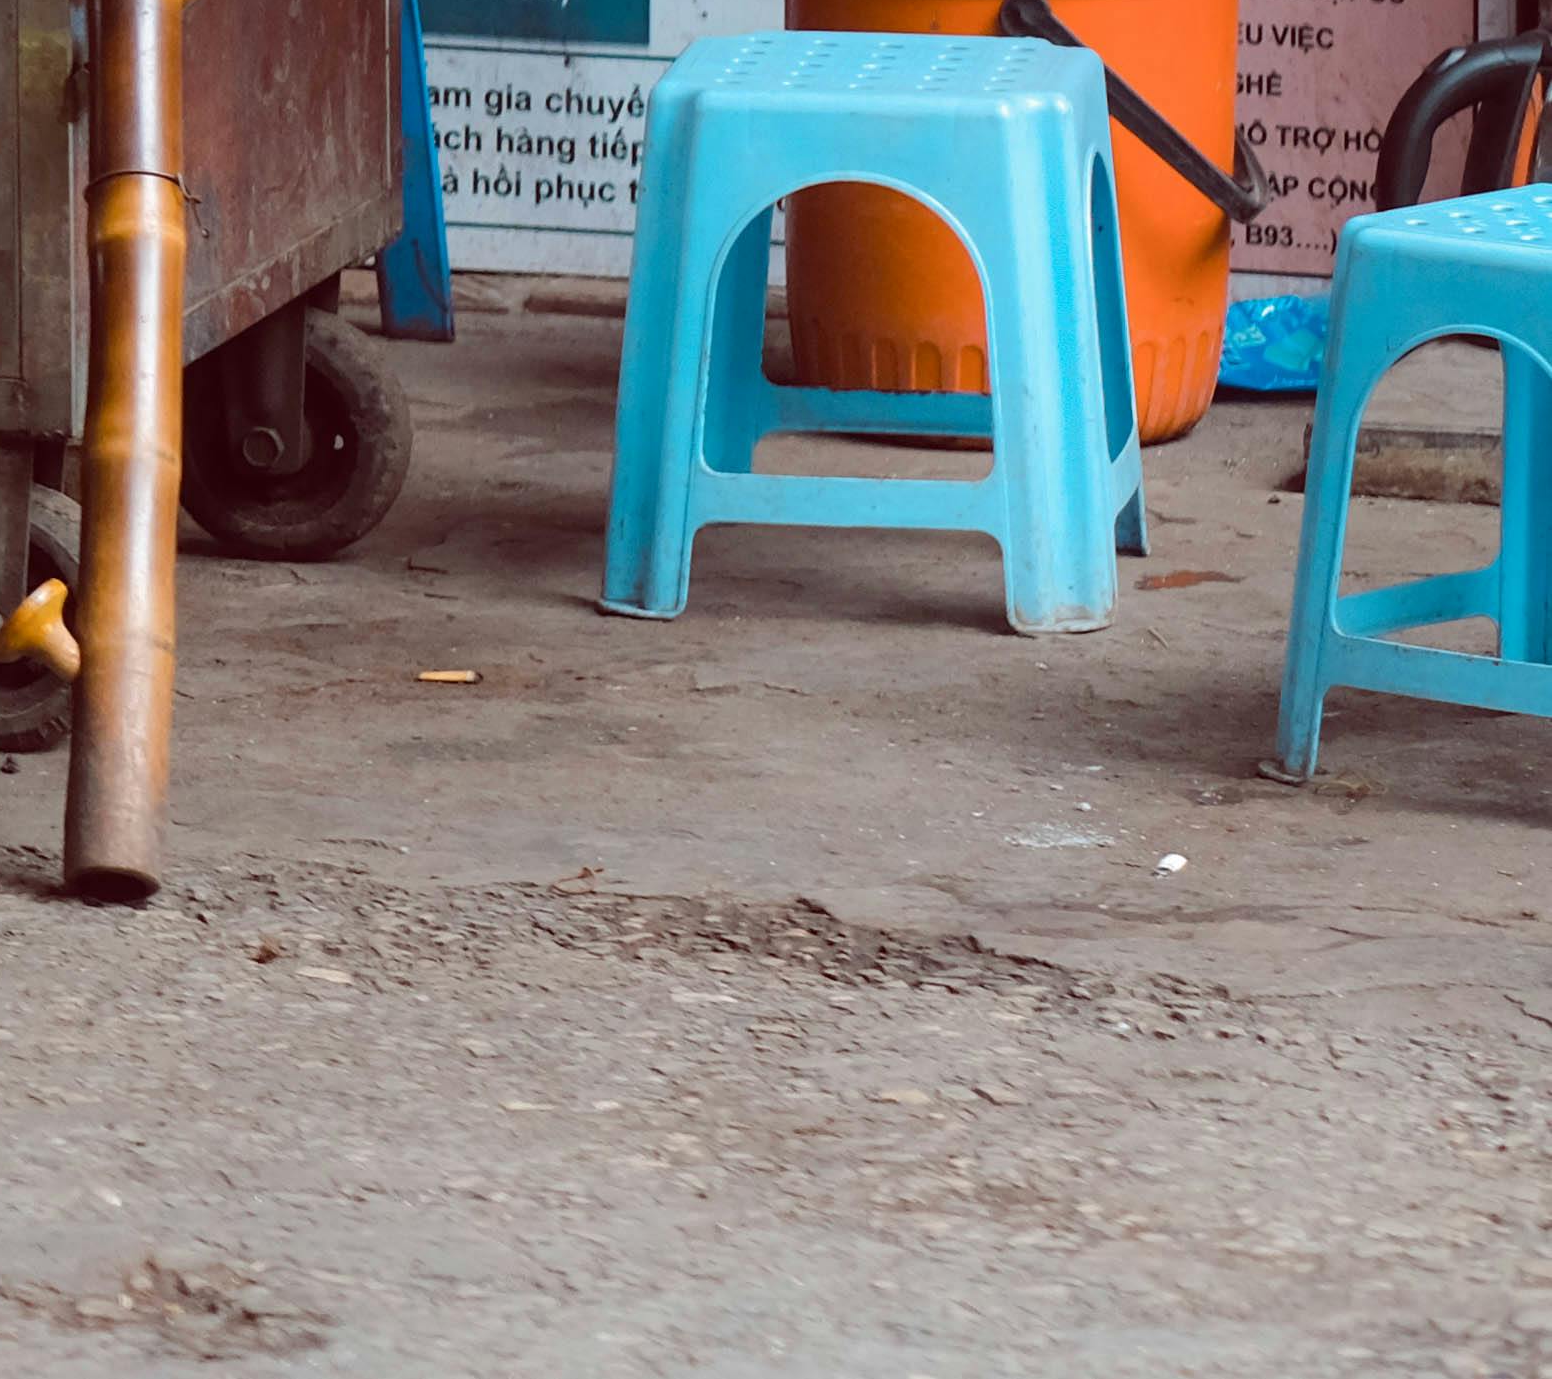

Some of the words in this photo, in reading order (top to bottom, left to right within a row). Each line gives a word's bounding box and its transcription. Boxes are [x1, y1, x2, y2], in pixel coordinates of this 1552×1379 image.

[1271, 23, 1335, 55] VIỆC
[484, 83, 532, 116] gia
[495, 126, 577, 163] hàng
[1276, 124, 1337, 156] TRỢ
[471, 167, 523, 198] hồi
[534, 172, 617, 208] phục
